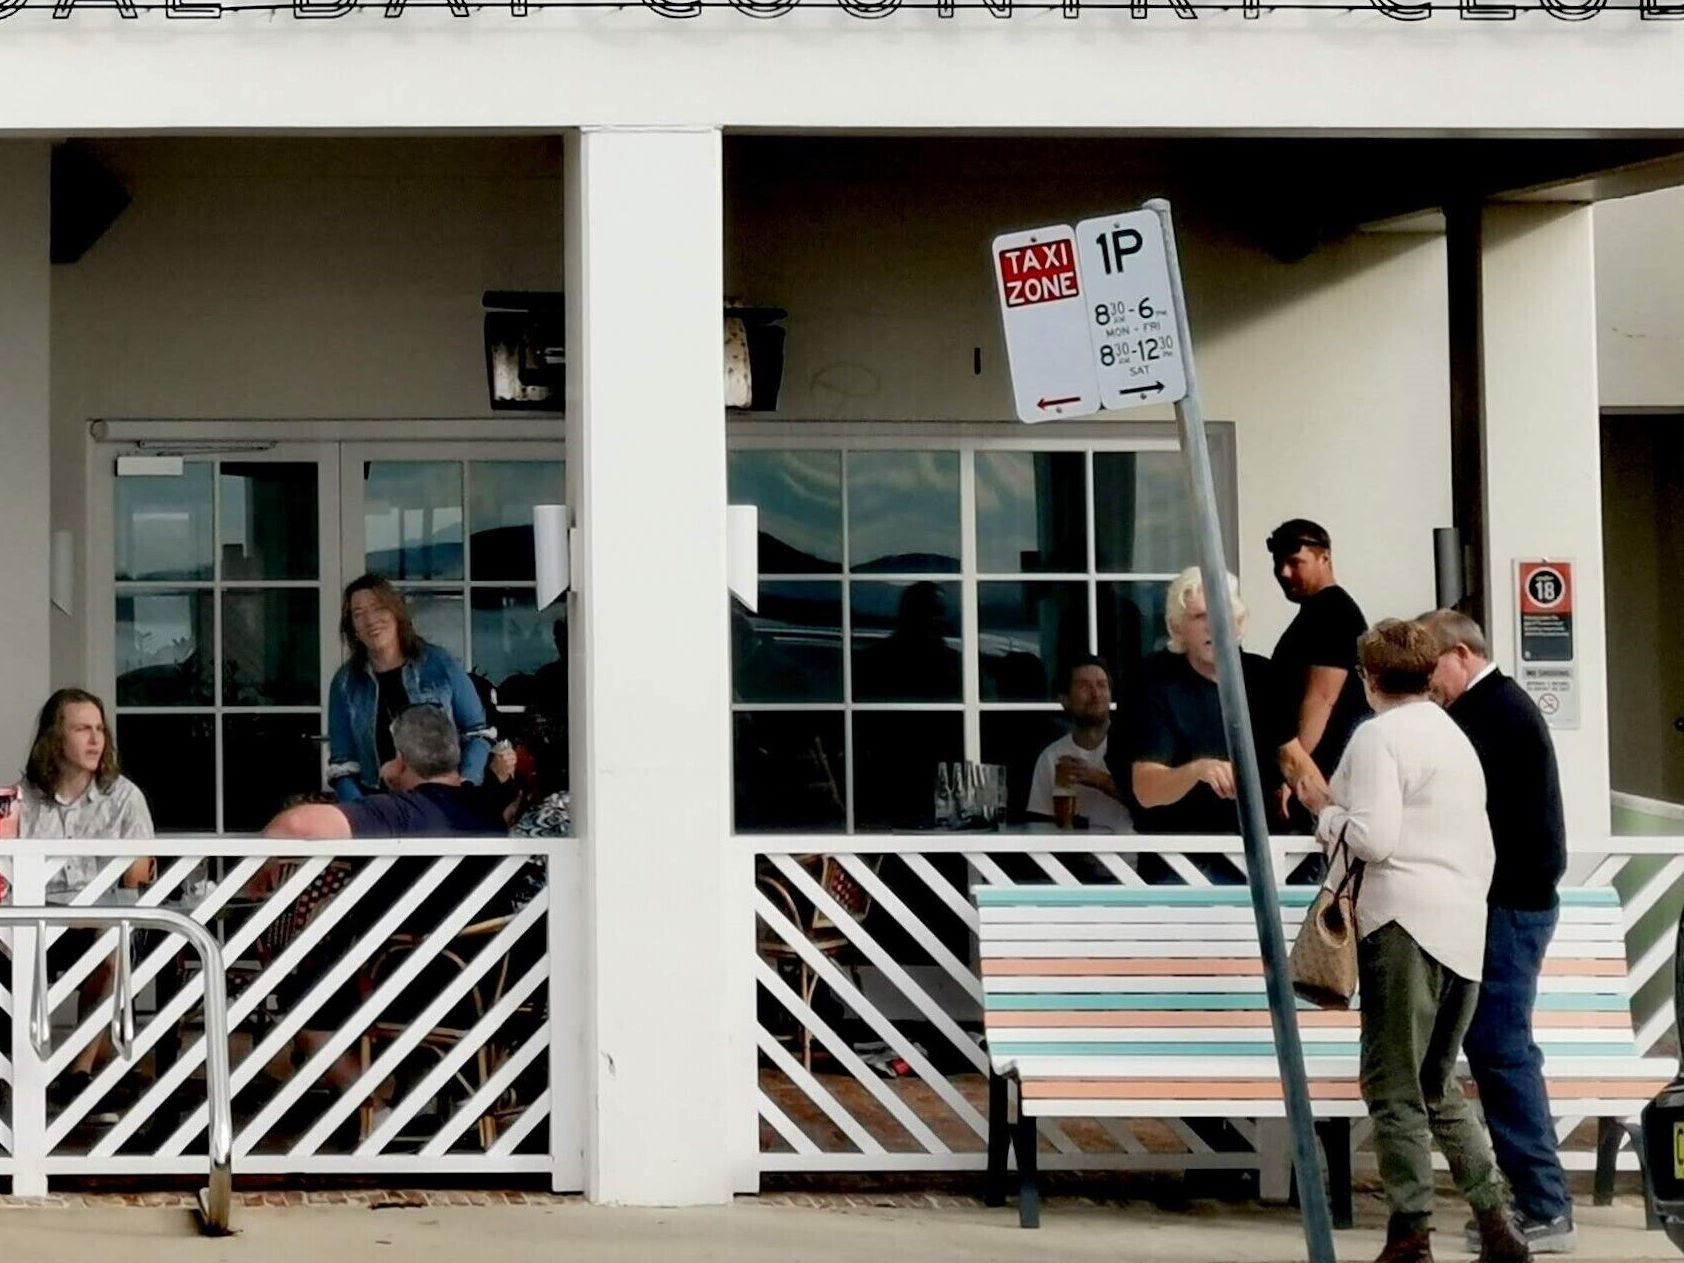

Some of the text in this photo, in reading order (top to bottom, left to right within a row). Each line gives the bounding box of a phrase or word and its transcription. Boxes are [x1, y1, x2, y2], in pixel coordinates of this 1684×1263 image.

[1005, 242, 1069, 275] TAXI
[1096, 228, 1144, 275] 1P
[1006, 271, 1078, 306] ZONE
[1129, 365, 1149, 377] SAT
[1535, 581, 1556, 601] 18
